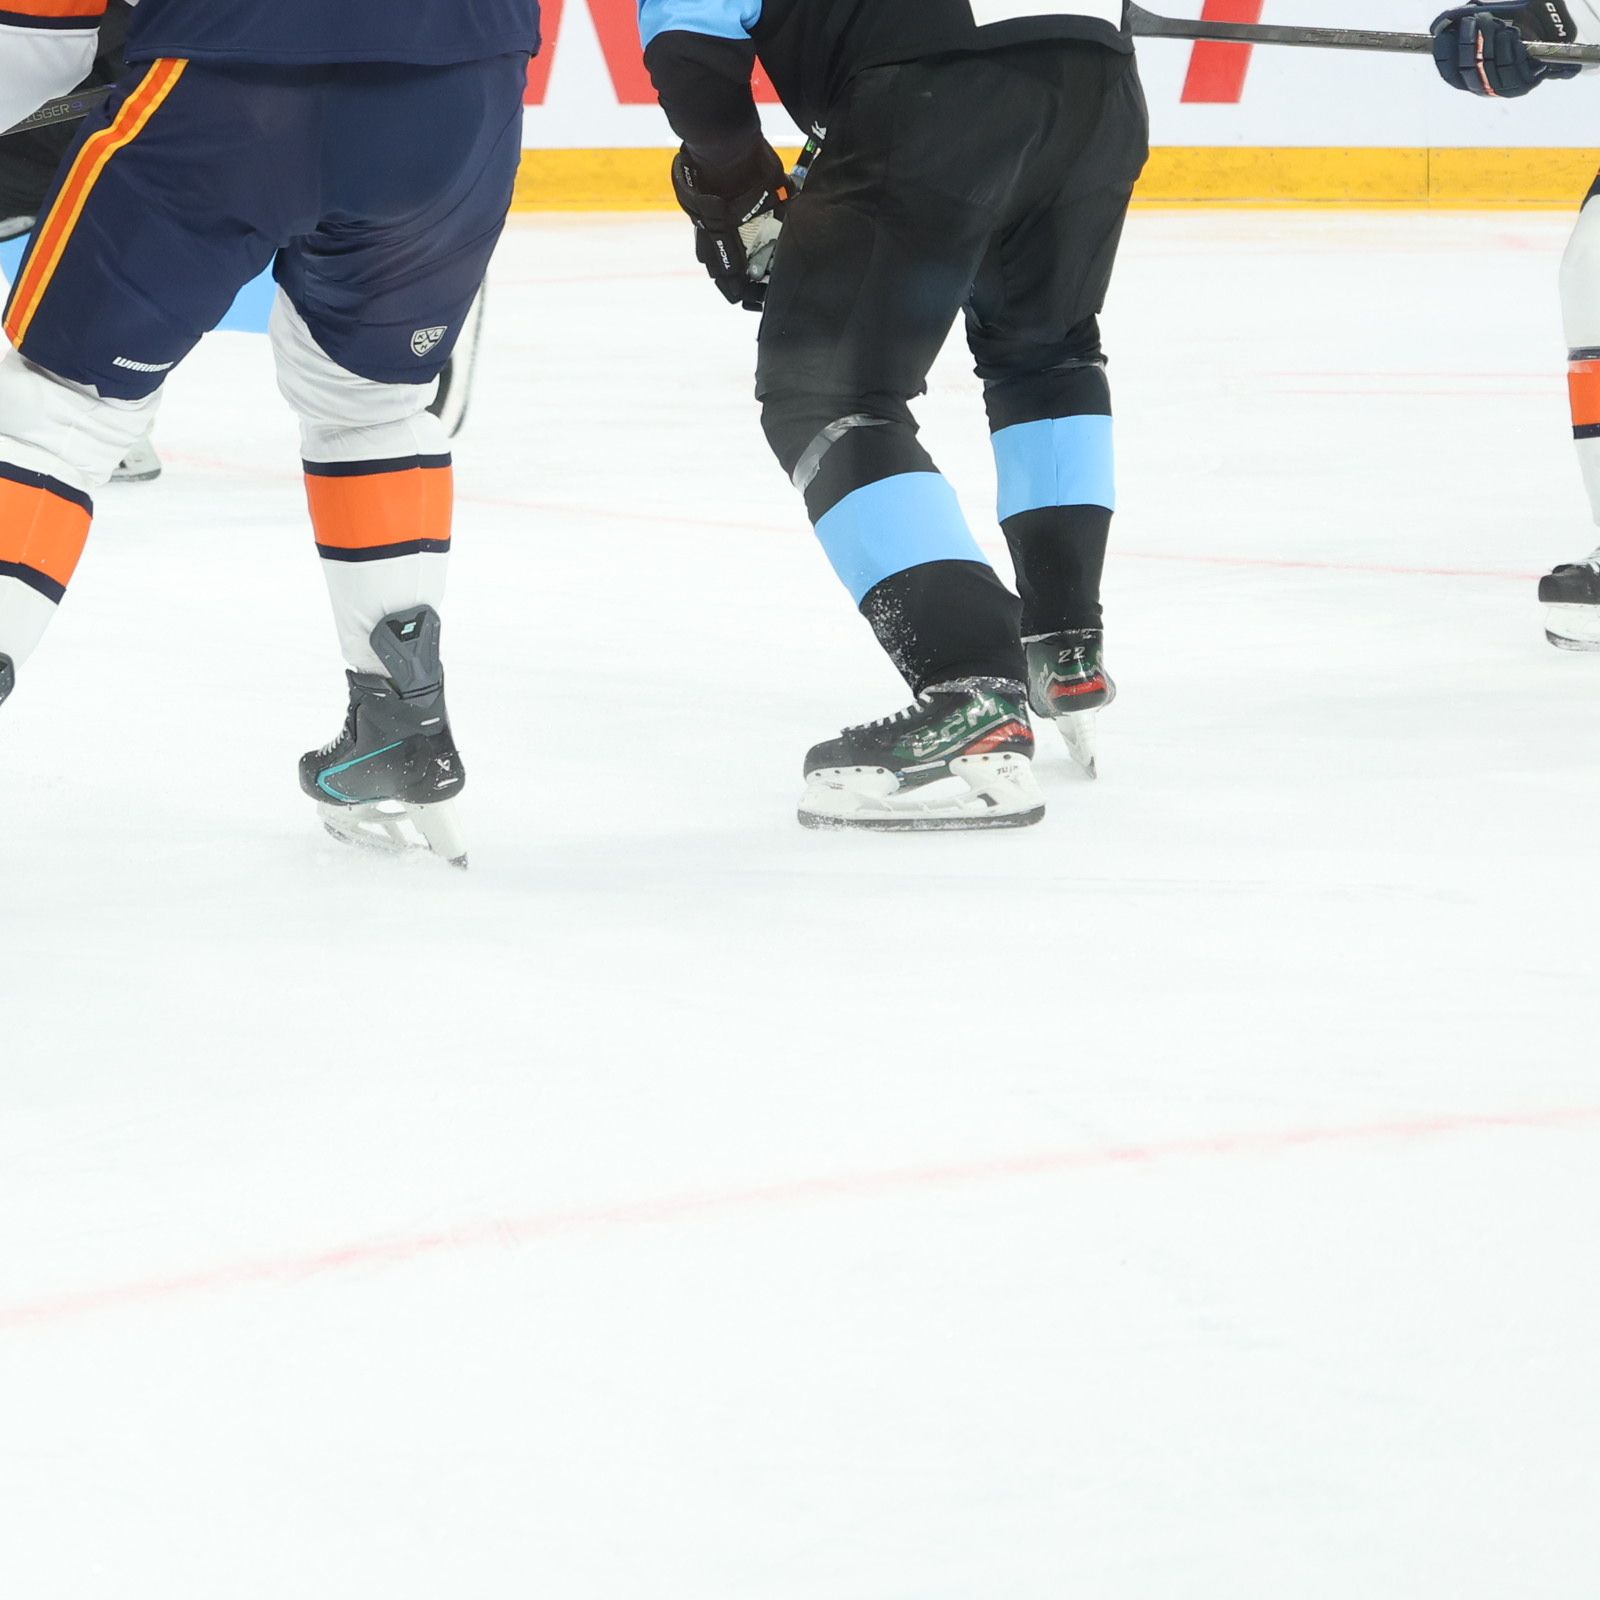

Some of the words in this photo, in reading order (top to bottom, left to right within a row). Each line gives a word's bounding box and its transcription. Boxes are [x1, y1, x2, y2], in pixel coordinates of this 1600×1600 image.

[1544, 1, 1567, 38] CCM
[716, 239, 731, 271] TACKS
[1058, 646, 1086, 664] 22
[911, 696, 999, 758] CCM
